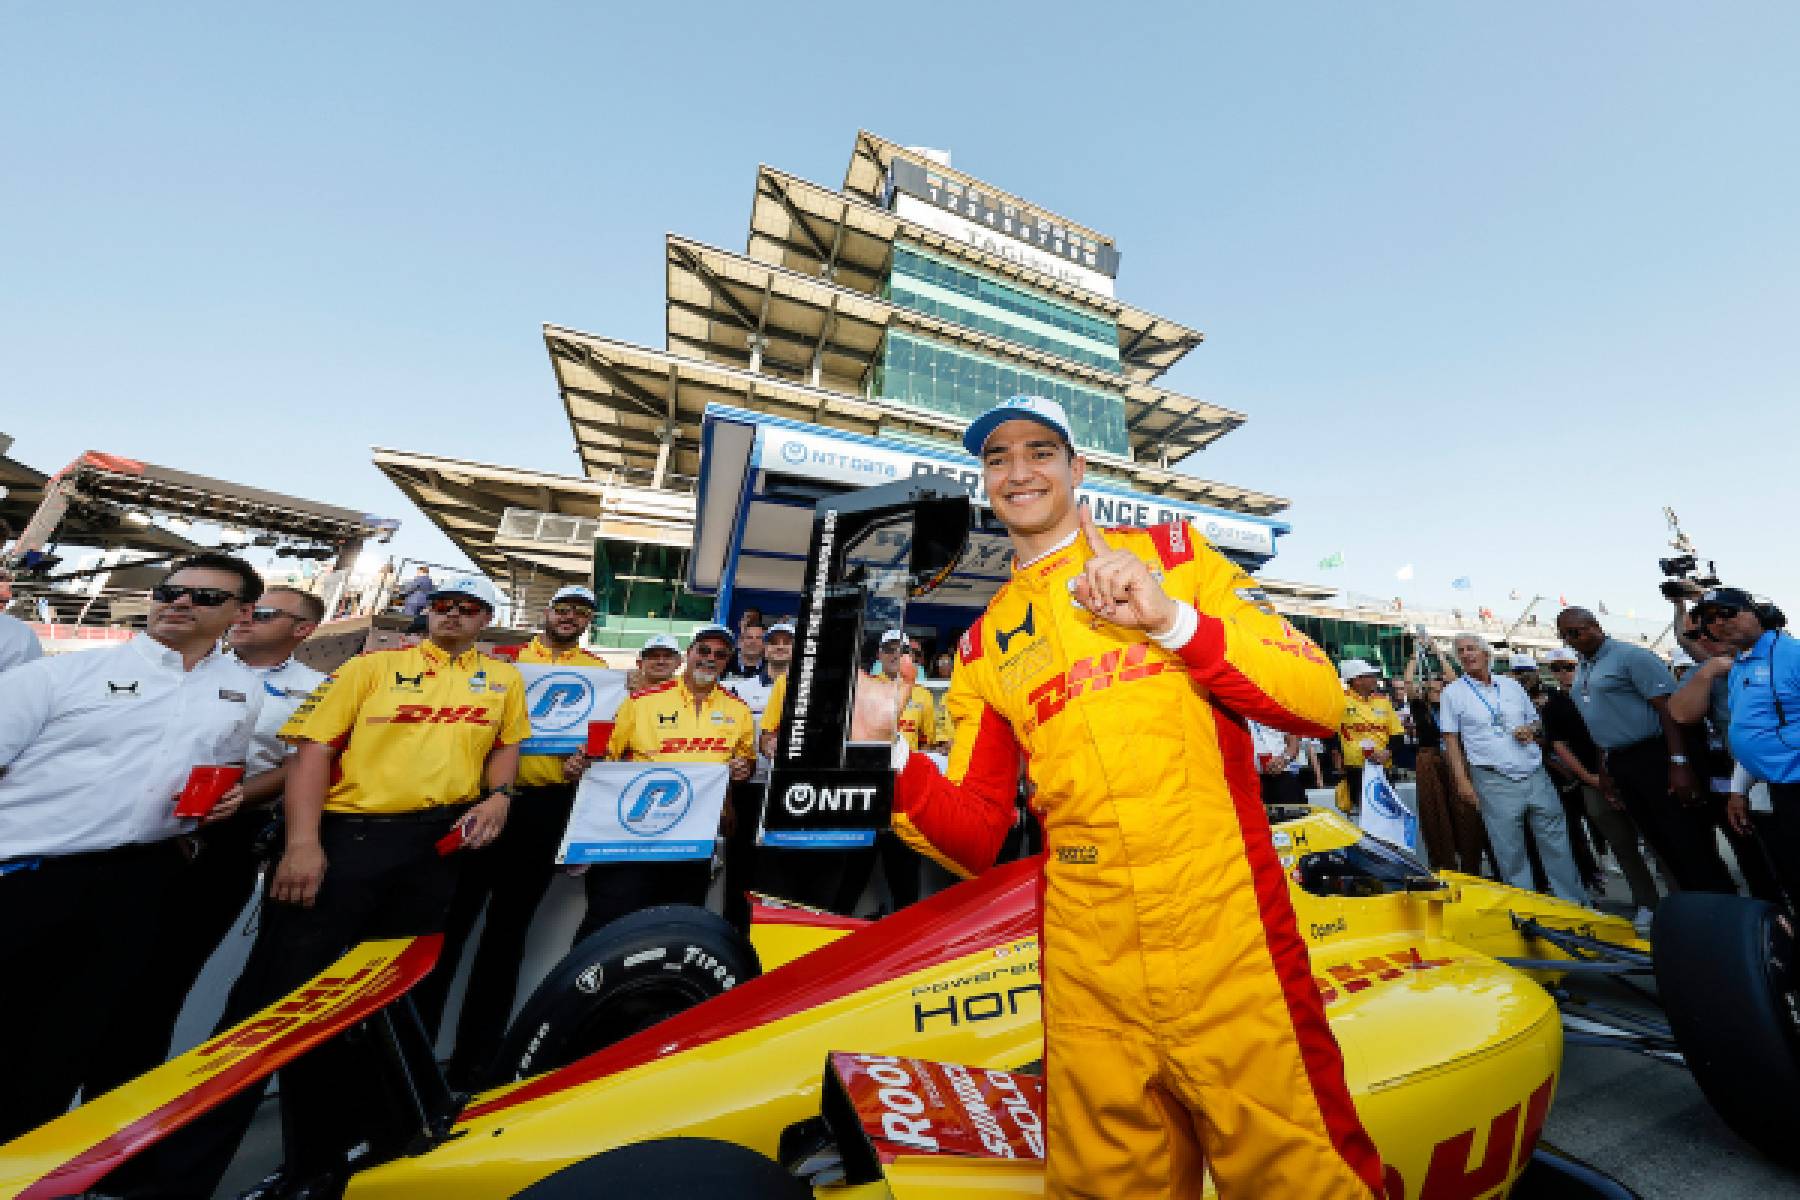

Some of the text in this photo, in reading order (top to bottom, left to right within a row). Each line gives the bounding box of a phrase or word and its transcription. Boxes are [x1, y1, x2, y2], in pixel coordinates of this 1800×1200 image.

[1028, 641, 1165, 726] DHL
[390, 704, 490, 724] DHL
[659, 737, 730, 753] DHL
[818, 787, 877, 812] NTT
[197, 967, 371, 1057] DHL
[914, 984, 1041, 1033] Hon
